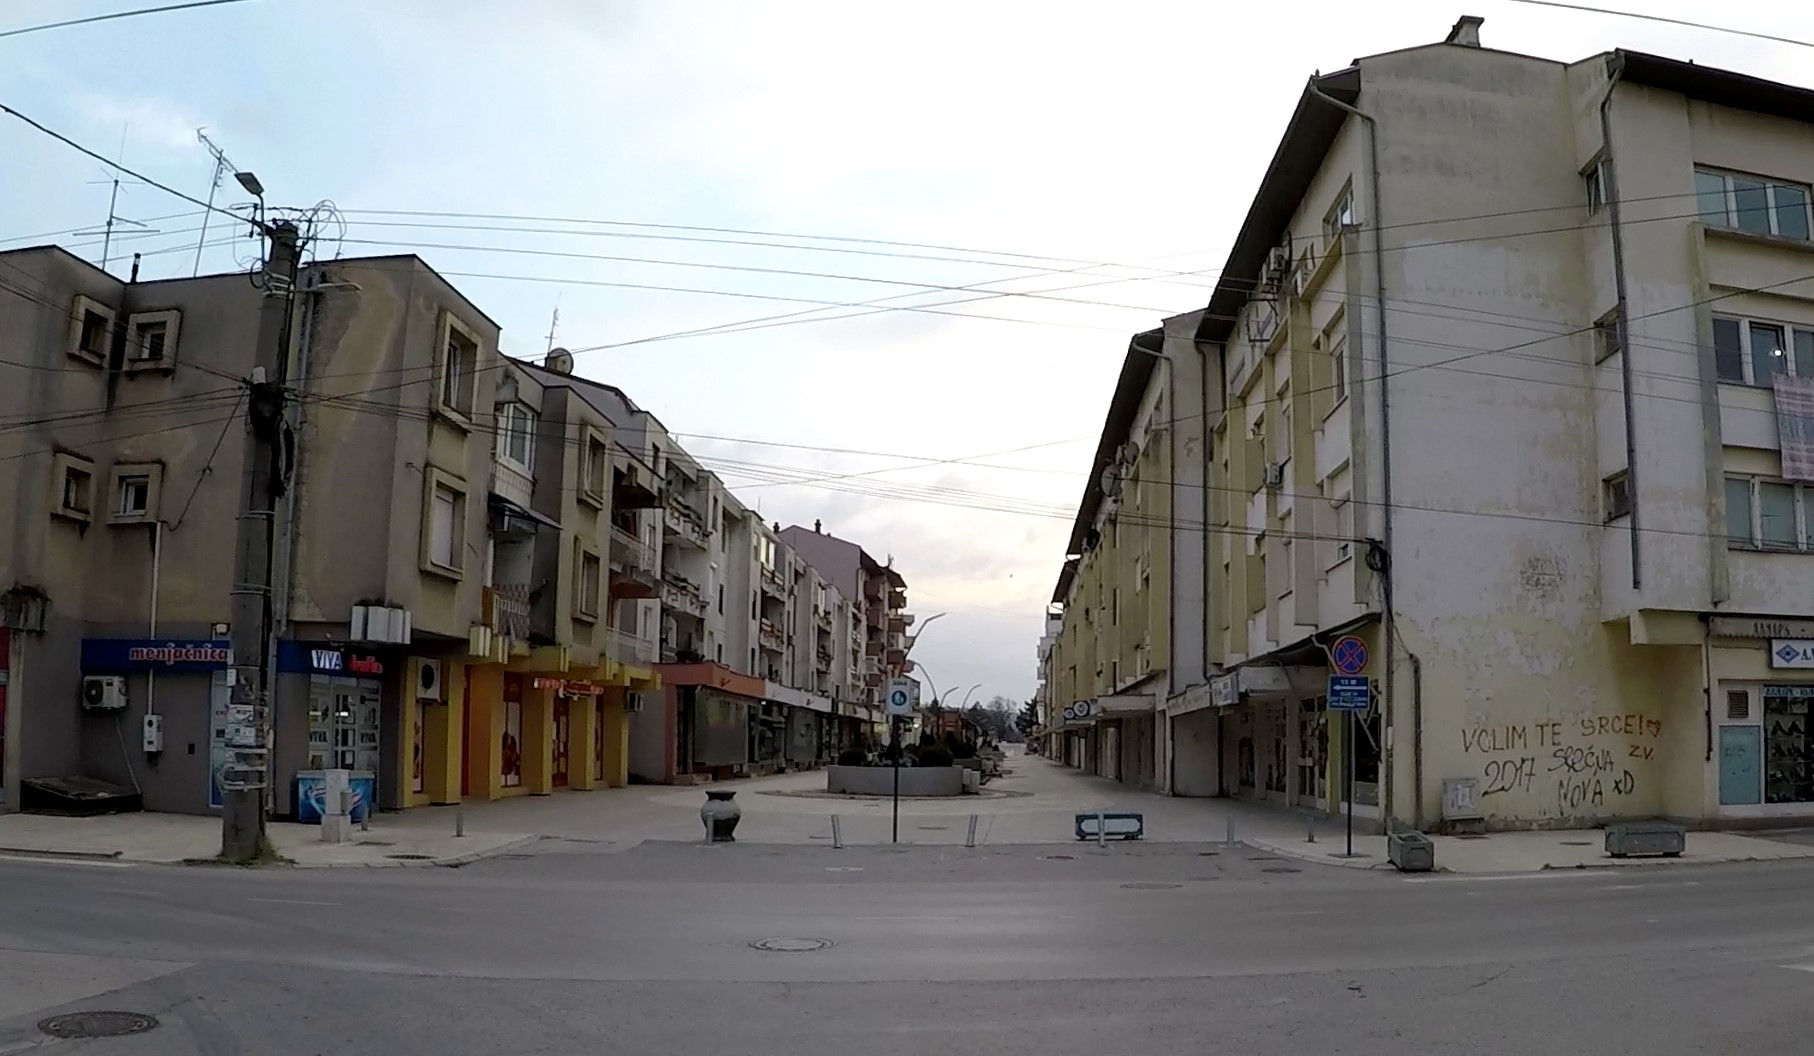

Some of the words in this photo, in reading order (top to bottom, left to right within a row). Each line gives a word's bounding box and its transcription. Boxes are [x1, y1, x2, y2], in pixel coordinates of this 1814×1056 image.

[128, 642, 227, 666] menjačnica
[311, 649, 342, 670] VIVA
[1462, 725, 1528, 752] VOLIM
[1535, 722, 1563, 746] TE
[1581, 714, 1643, 737] SRCE!
[1481, 757, 1536, 798] 2017
[1558, 776, 1604, 812] NOVA
